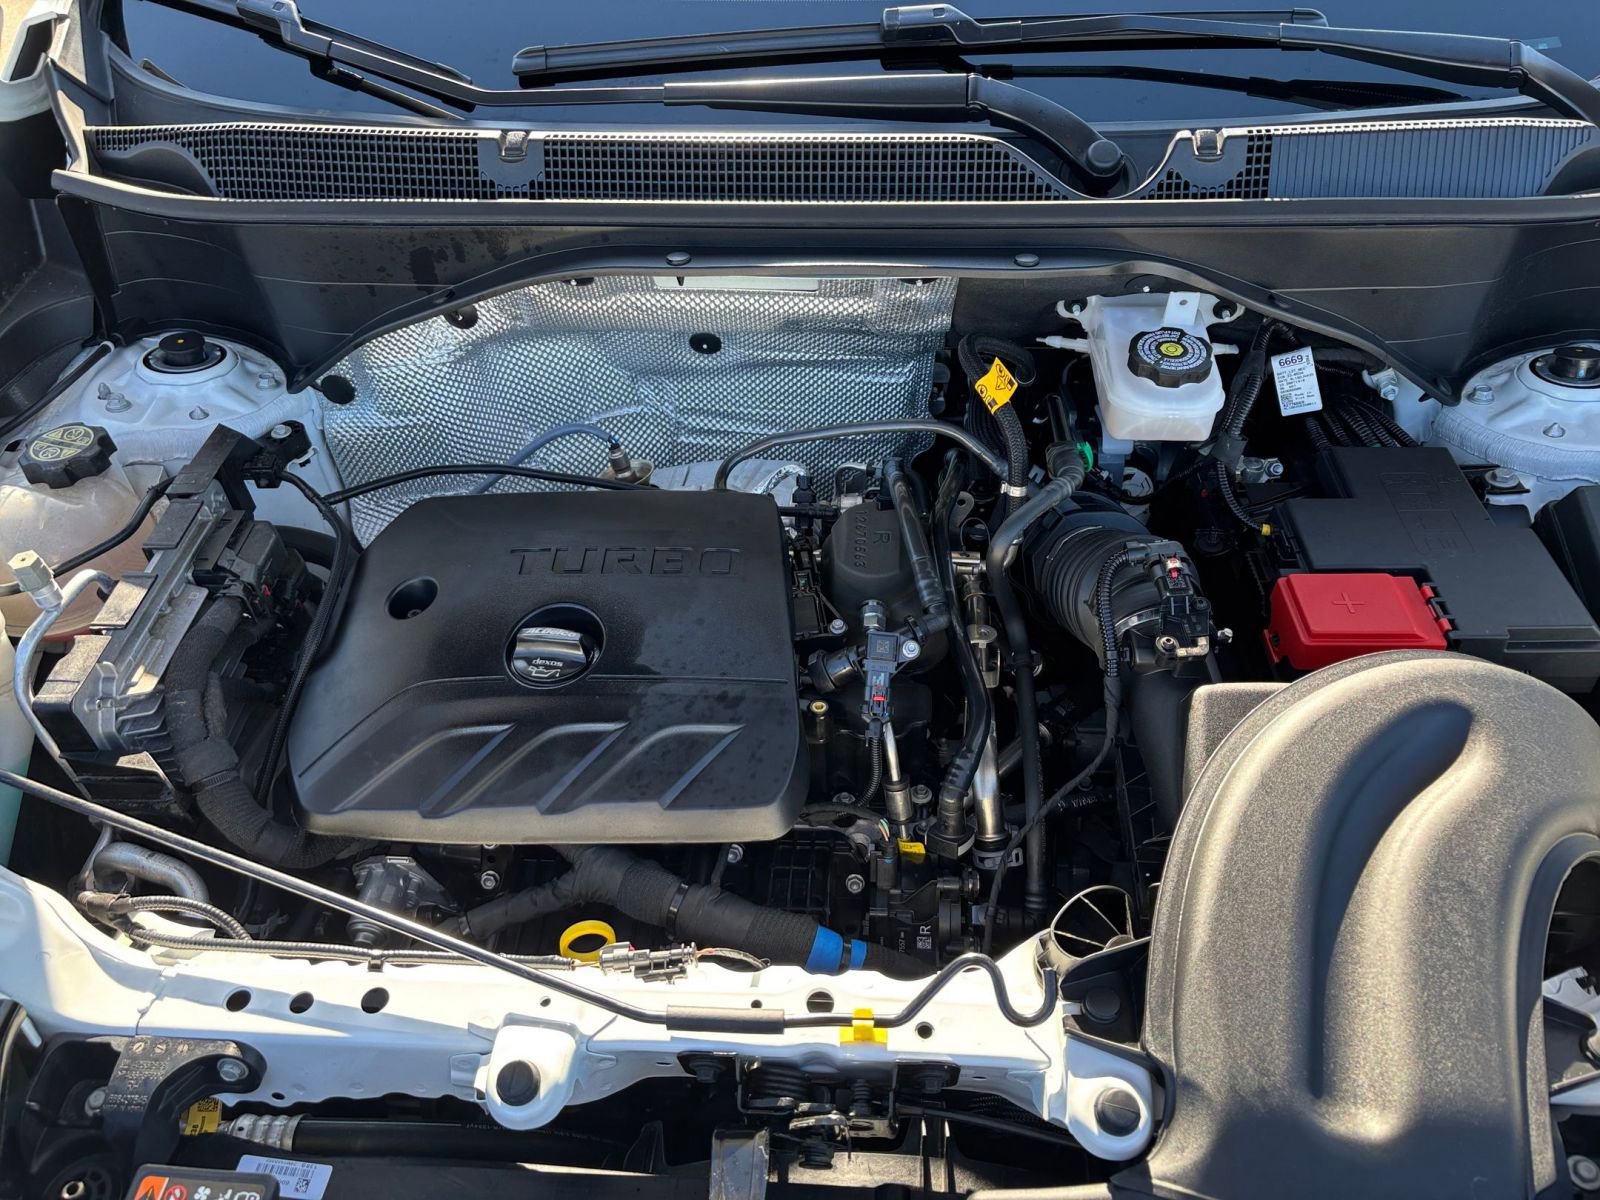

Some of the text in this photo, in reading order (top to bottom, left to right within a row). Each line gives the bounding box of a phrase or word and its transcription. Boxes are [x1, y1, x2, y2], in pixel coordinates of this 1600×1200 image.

[1279, 354, 1304, 367] 6669
[872, 530, 892, 544] R
[509, 546, 741, 576] TURBO
[531, 657, 564, 667] dexos
[920, 925, 931, 934] R
